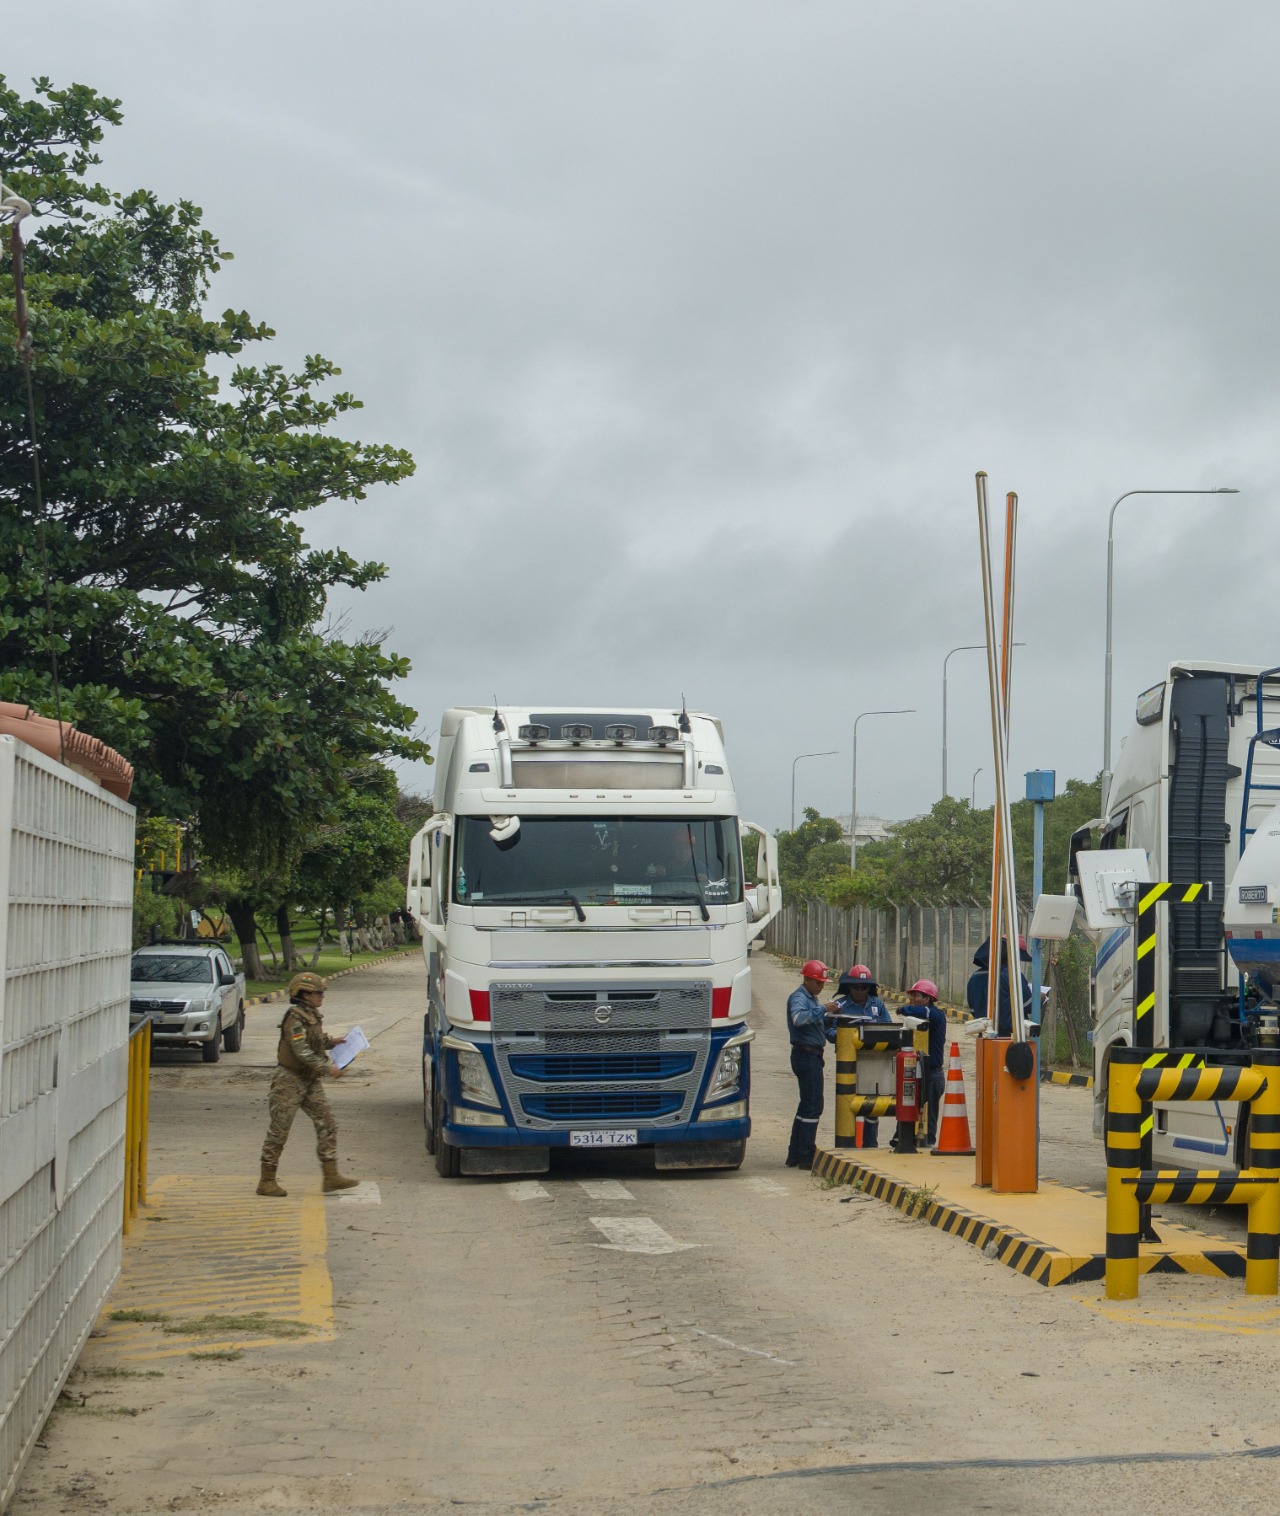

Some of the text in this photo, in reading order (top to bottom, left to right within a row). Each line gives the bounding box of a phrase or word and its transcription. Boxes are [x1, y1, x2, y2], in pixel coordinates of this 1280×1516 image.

[1240, 889, 1265, 900] ROBERTO
[495, 982, 534, 990] VOLVO
[573, 1133, 634, 1145] 5314 TZK
